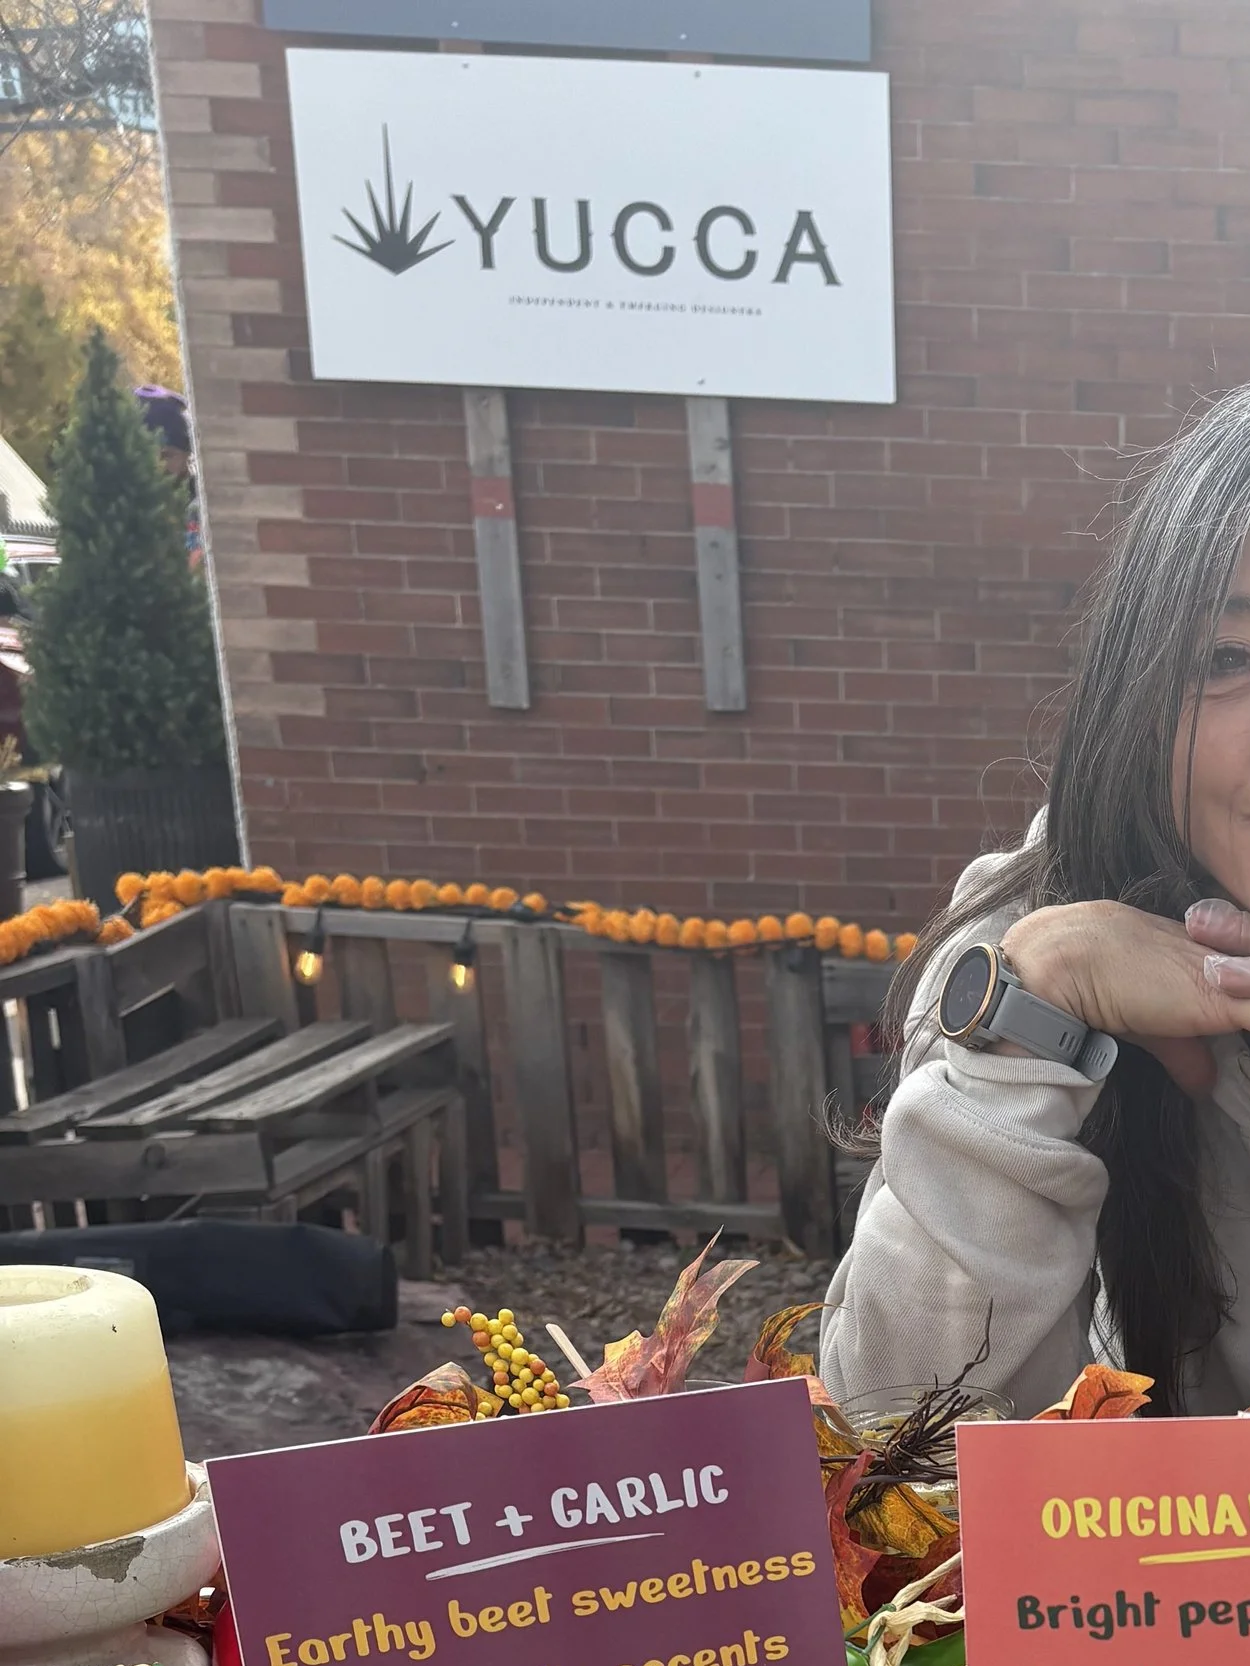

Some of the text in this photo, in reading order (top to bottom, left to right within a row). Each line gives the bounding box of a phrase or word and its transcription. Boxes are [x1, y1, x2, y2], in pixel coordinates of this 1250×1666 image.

[451, 194, 842, 287] YUCCA
[339, 1463, 730, 1564] BEET + GARLIC
[447, 1585, 554, 1639] beet
[571, 1550, 817, 1615] sweetness
[1015, 1589, 1162, 1641] Bright
